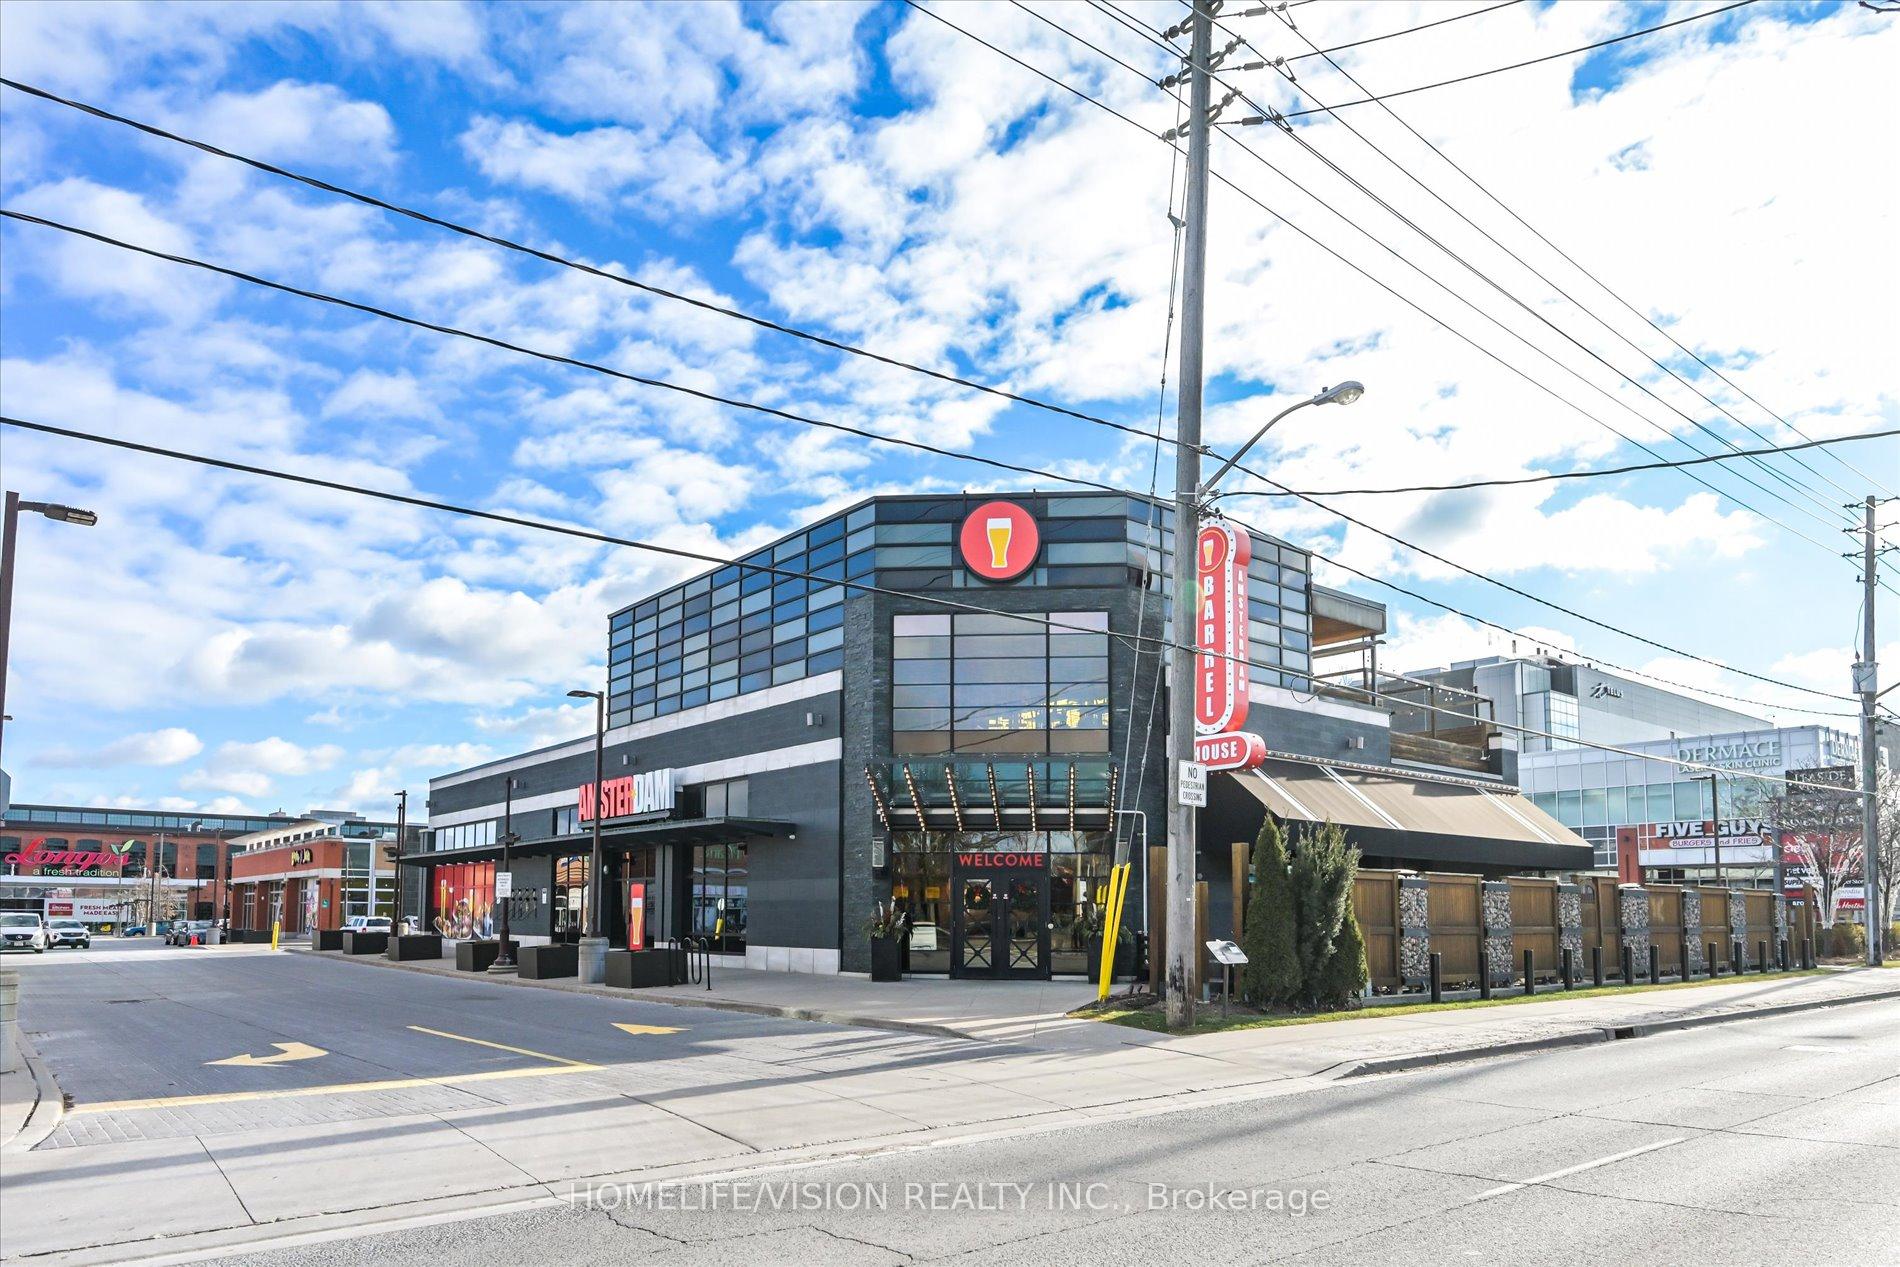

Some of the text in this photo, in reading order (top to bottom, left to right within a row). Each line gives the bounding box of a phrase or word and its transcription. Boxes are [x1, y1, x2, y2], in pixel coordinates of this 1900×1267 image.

[1237, 569, 1246, 692] AMSTERDAM
[1203, 575, 1215, 718] BARREL
[1677, 741, 1781, 763] DERMACE
[1187, 767, 1198, 779] NO
[1677, 764, 1709, 774] LASE
[1719, 760, 1743, 770] SKIN
[1745, 757, 1780, 768] CLINIC
[1180, 779, 1205, 791] PEDESTRIAN
[578, 768, 675, 822] AMSTERDAM
[1182, 791, 1203, 802] CROSSING
[1656, 821, 1704, 838] FIVE
[1713, 819, 1772, 837] GUYS
[1672, 839, 1712, 847] BURGERS
[1732, 837, 1758, 845] FRIES
[959, 853, 1044, 867] WELCOME
[32, 867, 120, 877] a fresh tradition
